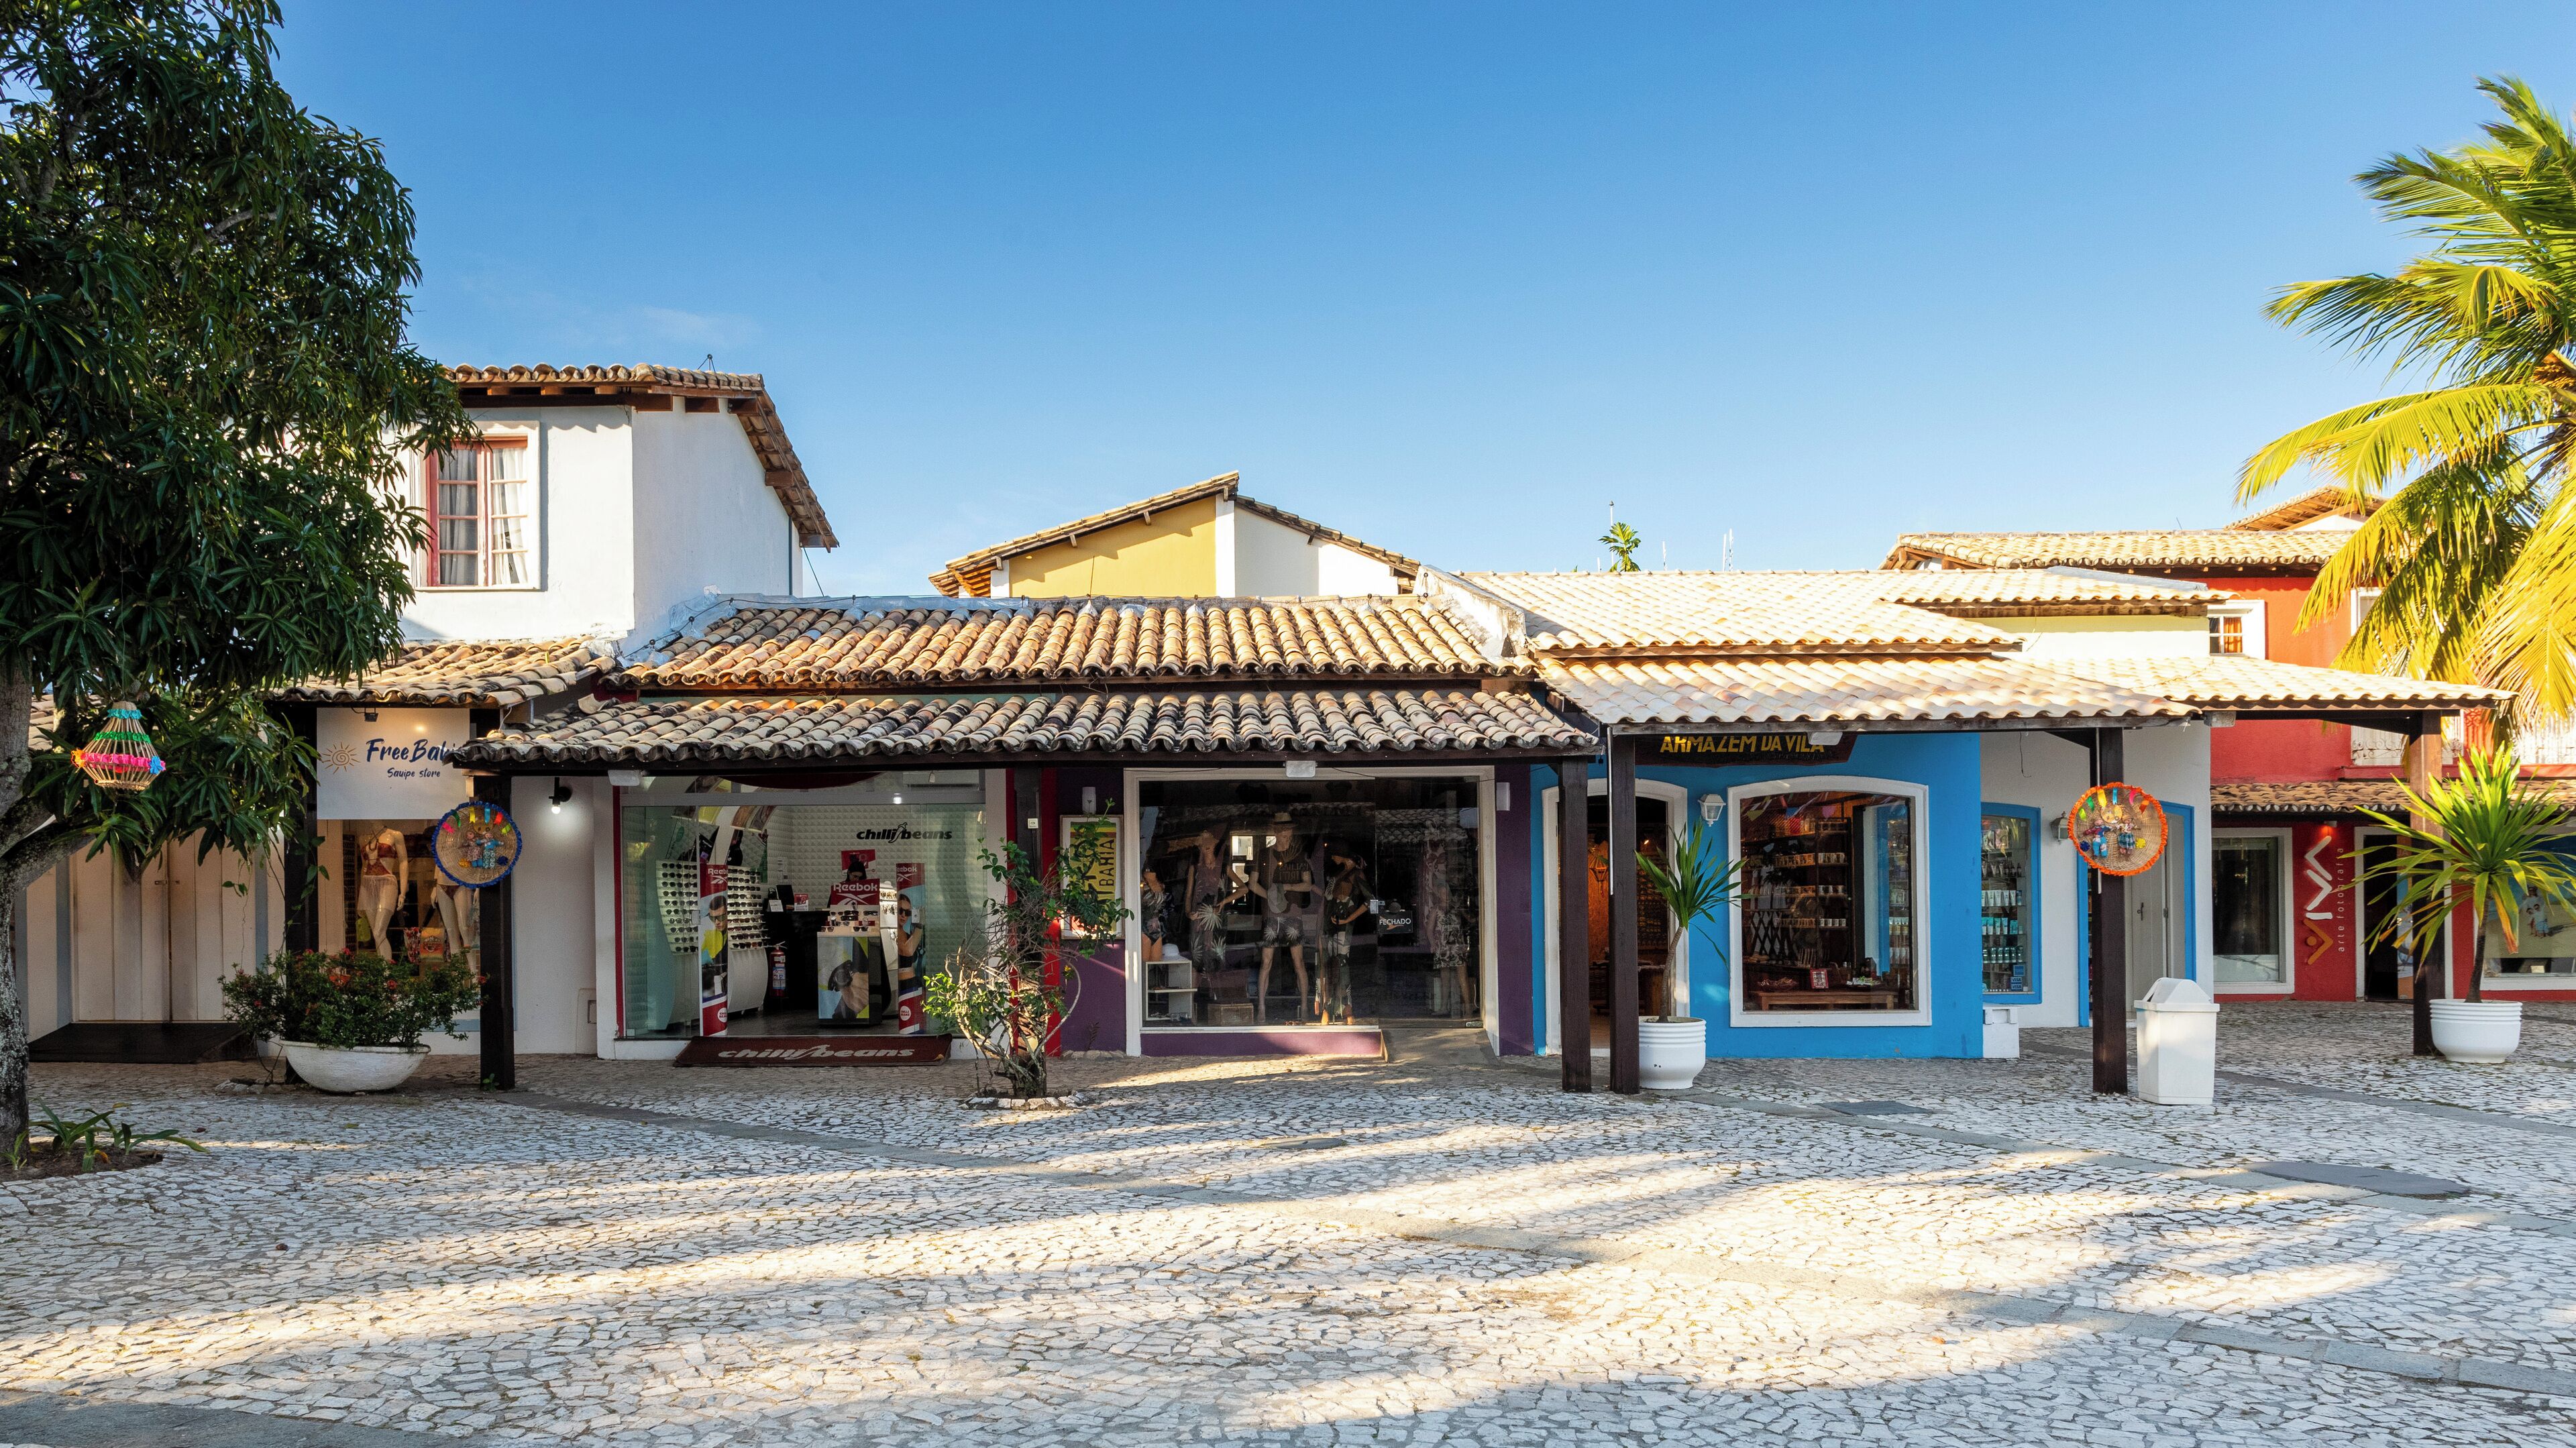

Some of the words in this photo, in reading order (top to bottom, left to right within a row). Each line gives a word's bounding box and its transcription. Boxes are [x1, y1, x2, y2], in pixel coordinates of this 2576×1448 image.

[1660, 736, 1756, 753] ARMAZEM
[1760, 735, 1782, 751] DA
[387, 767, 415, 780] Sauipe
[419, 768, 441, 778] store
[1099, 838, 1114, 887] BAHIA
[833, 883, 878, 891] Reebok
[2336, 848, 2345, 919] fotorafa
[2337, 926, 2345, 952] arte
